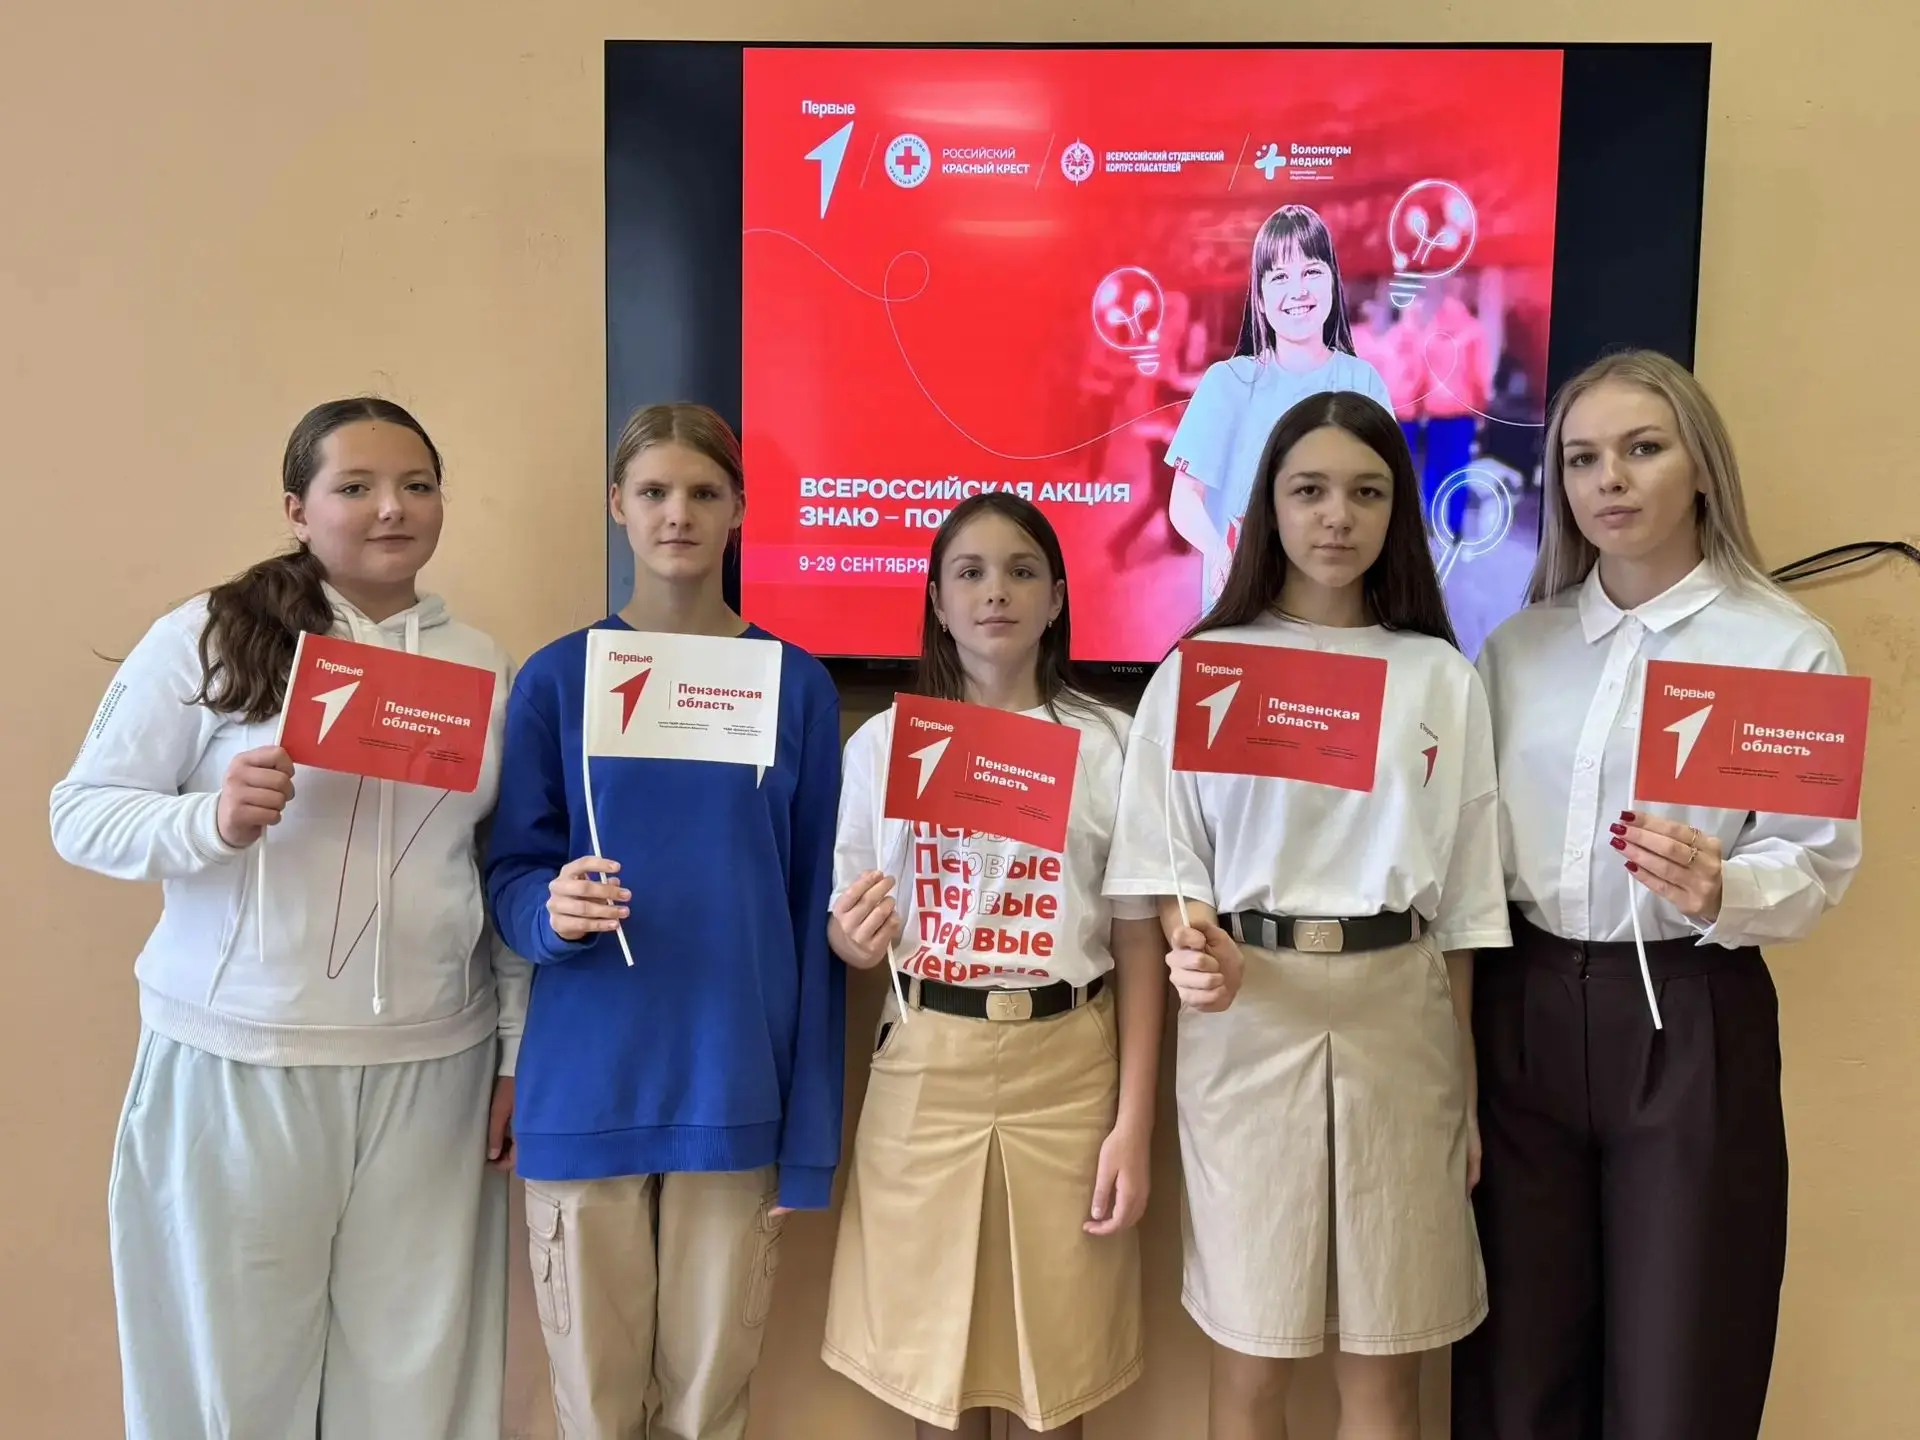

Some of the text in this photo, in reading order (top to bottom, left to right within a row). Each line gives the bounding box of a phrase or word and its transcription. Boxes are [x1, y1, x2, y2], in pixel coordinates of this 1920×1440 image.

[802, 100, 856, 118] Первые
[942, 146, 1016, 159] РОССИЙСКИЙ
[1105, 150, 1224, 162] ВСЕРОССИЙСКИЙ СТУДЕНЧЕСКИЙ
[1291, 143, 1352, 157] Волонтеры
[942, 161, 1030, 174] КРАСНЫЙ КРЕСТ
[1105, 162, 1181, 172] КОРПУС СПАСАТЕЛЕЙ
[1290, 157, 1333, 167] медики
[800, 477, 1131, 506] ВСЕРОССИЙСКАЯ АКЦИЯ
[800, 507, 879, 528] ЗНАЮ
[799, 556, 928, 573] 9-29 СЕНТЯБРЯ
[608, 651, 653, 665] Первые
[316, 658, 364, 677] Первые
[1196, 662, 1243, 677] Первые
[678, 683, 762, 699] Пензенская
[1663, 685, 1716, 700] Первые
[677, 698, 735, 711] область
[1268, 697, 1361, 721] Пензенская
[384, 701, 471, 727] Пензенская
[1267, 714, 1329, 731] область
[382, 716, 441, 736] область
[910, 716, 954, 733] Первые
[1743, 723, 1845, 743] Пензенская
[1741, 740, 1811, 757] область
[975, 755, 1057, 785] Пензенская
[973, 771, 1028, 792] область
[915, 842, 1062, 884] Первые
[915, 878, 1059, 920] Первые
[919, 911, 1054, 957] Первые
